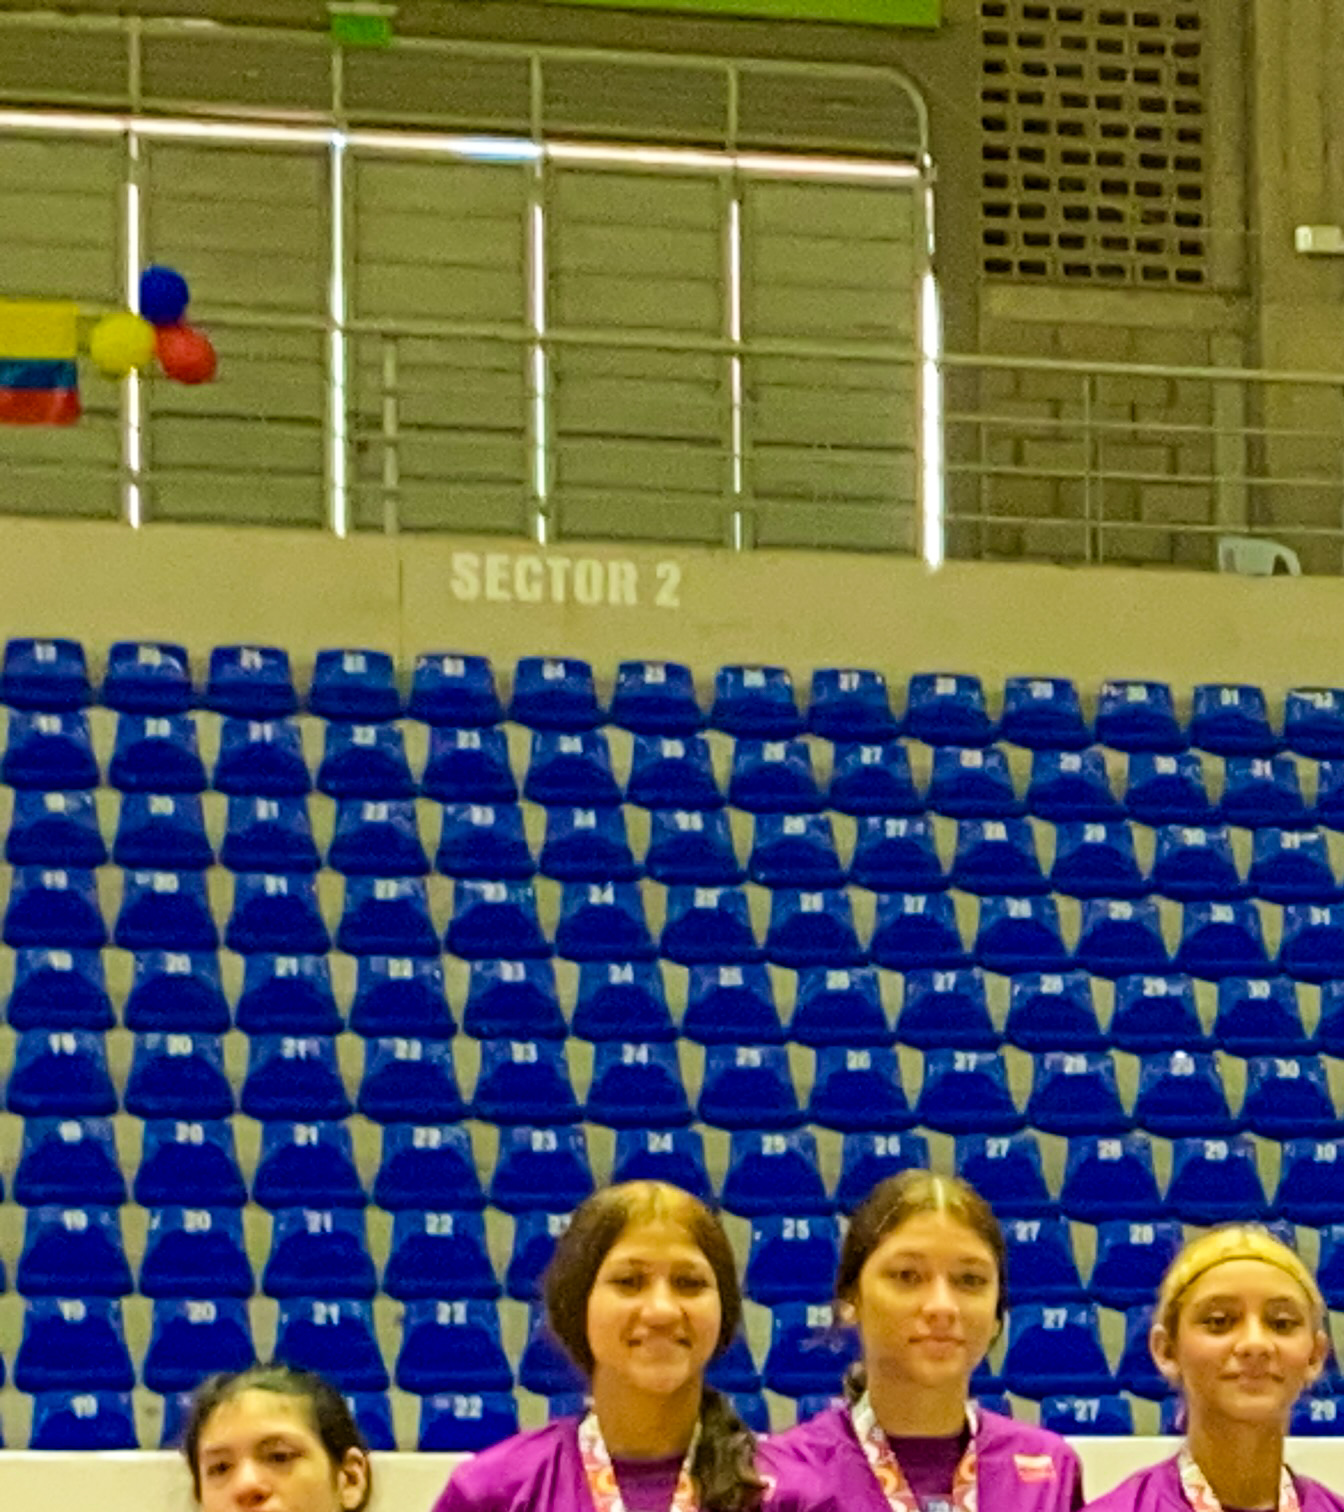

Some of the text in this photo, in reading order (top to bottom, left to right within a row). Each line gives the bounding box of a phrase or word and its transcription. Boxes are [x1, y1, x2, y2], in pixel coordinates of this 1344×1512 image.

[451, 552, 681, 607] SECTOR 2
[648, 1132, 672, 1152] 24
[986, 1138, 1010, 1158] 27
[426, 1213, 453, 1234] 22
[783, 1218, 809, 1239] 25
